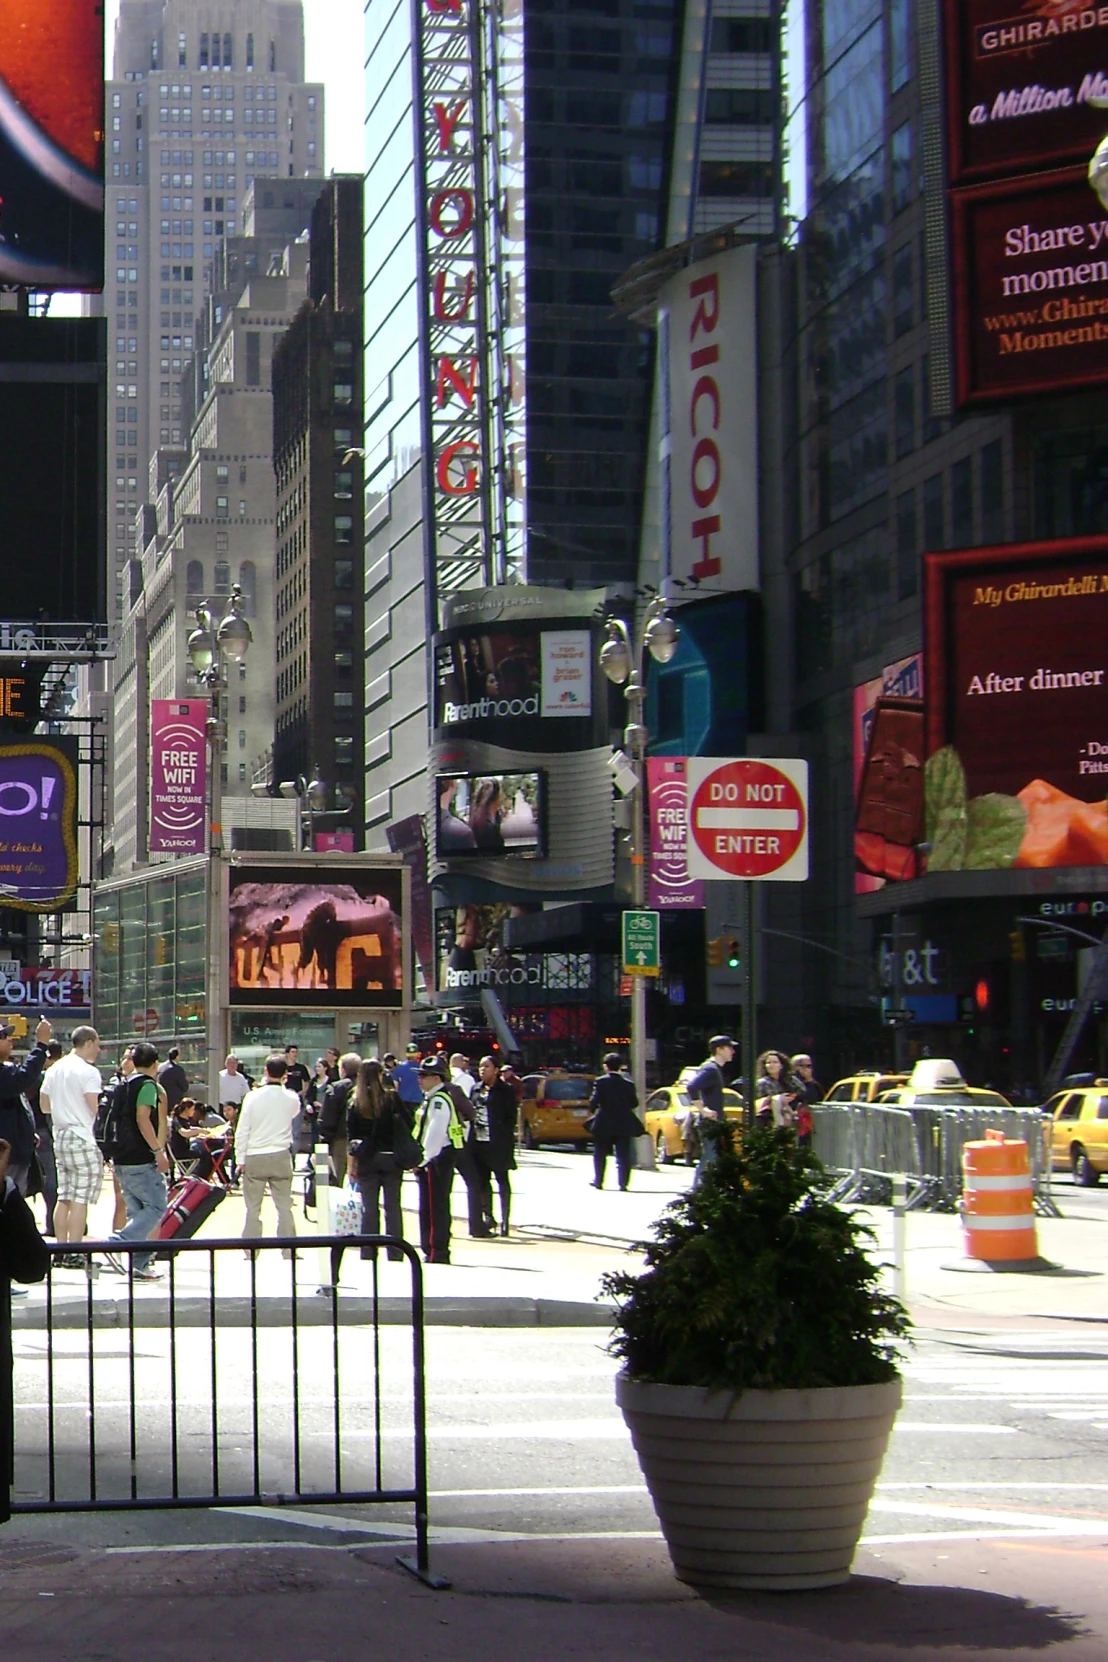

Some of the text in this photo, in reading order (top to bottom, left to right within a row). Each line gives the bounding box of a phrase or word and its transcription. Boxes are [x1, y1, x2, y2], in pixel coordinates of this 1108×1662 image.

[968, 103, 987, 125] a
[991, 85, 1073, 120] Million
[1005, 225, 1085, 257] Share
[430, 100, 479, 495] YOUNG
[689, 271, 721, 579] RICOH
[973, 587, 1002, 607] My
[1005, 575, 1098, 602] Ghirardelli
[967, 668, 1104, 696] After dinner
[443, 694, 539, 724] Parenthood
[161, 750, 198, 767] FREE
[163, 768, 195, 784] WIFI
[167, 786, 191, 794] NOW IN
[711, 784, 785, 802] DO NOT
[156, 795, 202, 804] TIMES SQUARE
[12, 843, 42, 852] checks
[159, 838, 196, 848] YAHOO!
[715, 835, 780, 855] ENTER
[653, 852, 672, 860] TIMES
[629, 941, 653, 950] South
